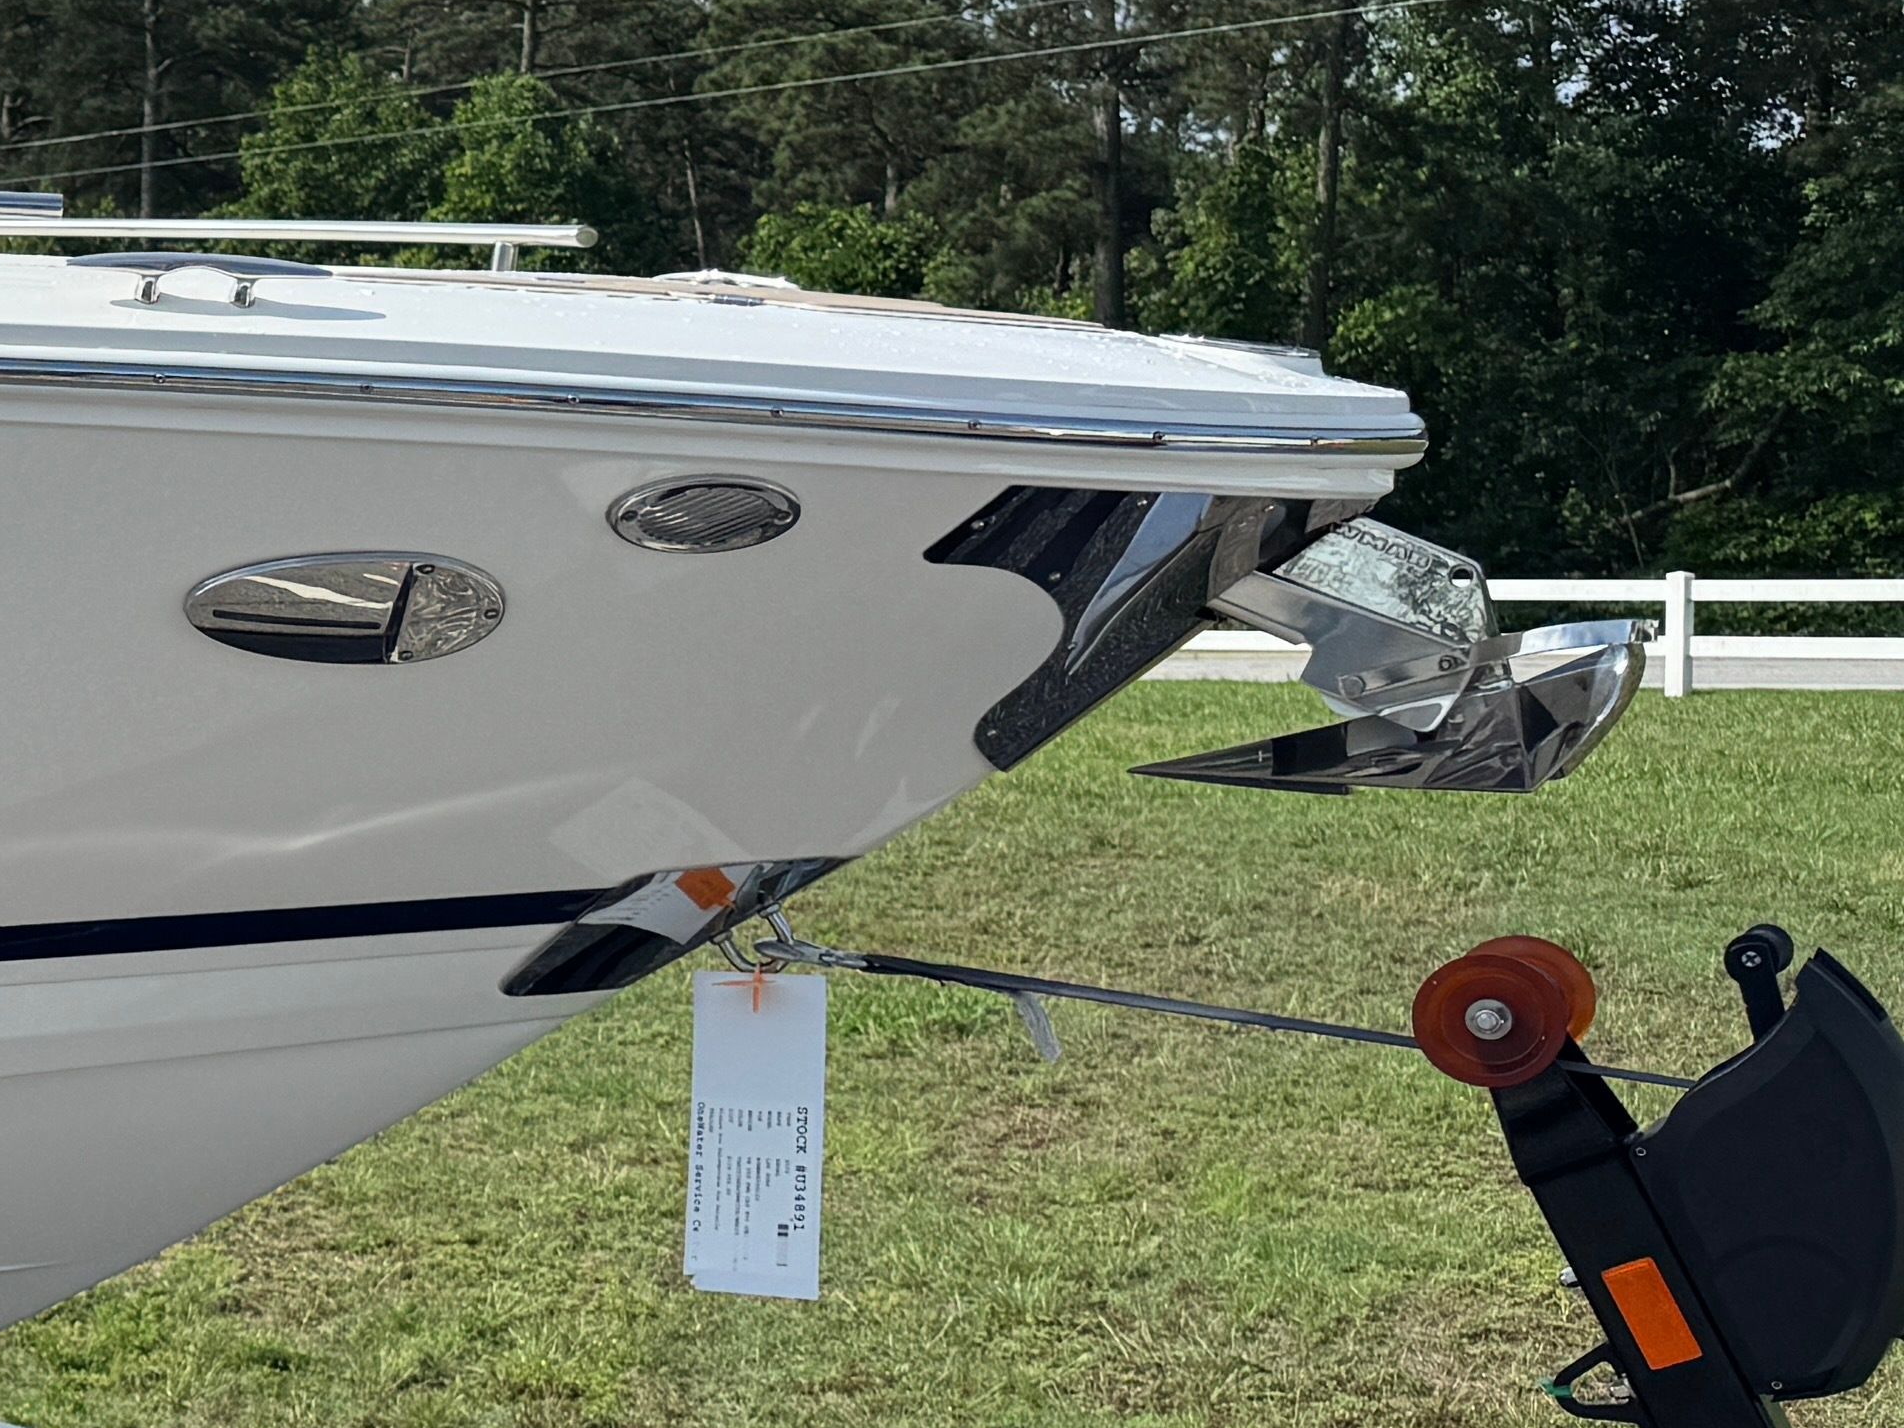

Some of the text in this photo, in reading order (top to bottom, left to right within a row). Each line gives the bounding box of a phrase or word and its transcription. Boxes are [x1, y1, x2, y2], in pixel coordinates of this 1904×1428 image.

[695, 1101, 706, 1157] OneWater
[693, 1164, 704, 1213] Service
[793, 1106, 808, 1231] STOCK #U34891
